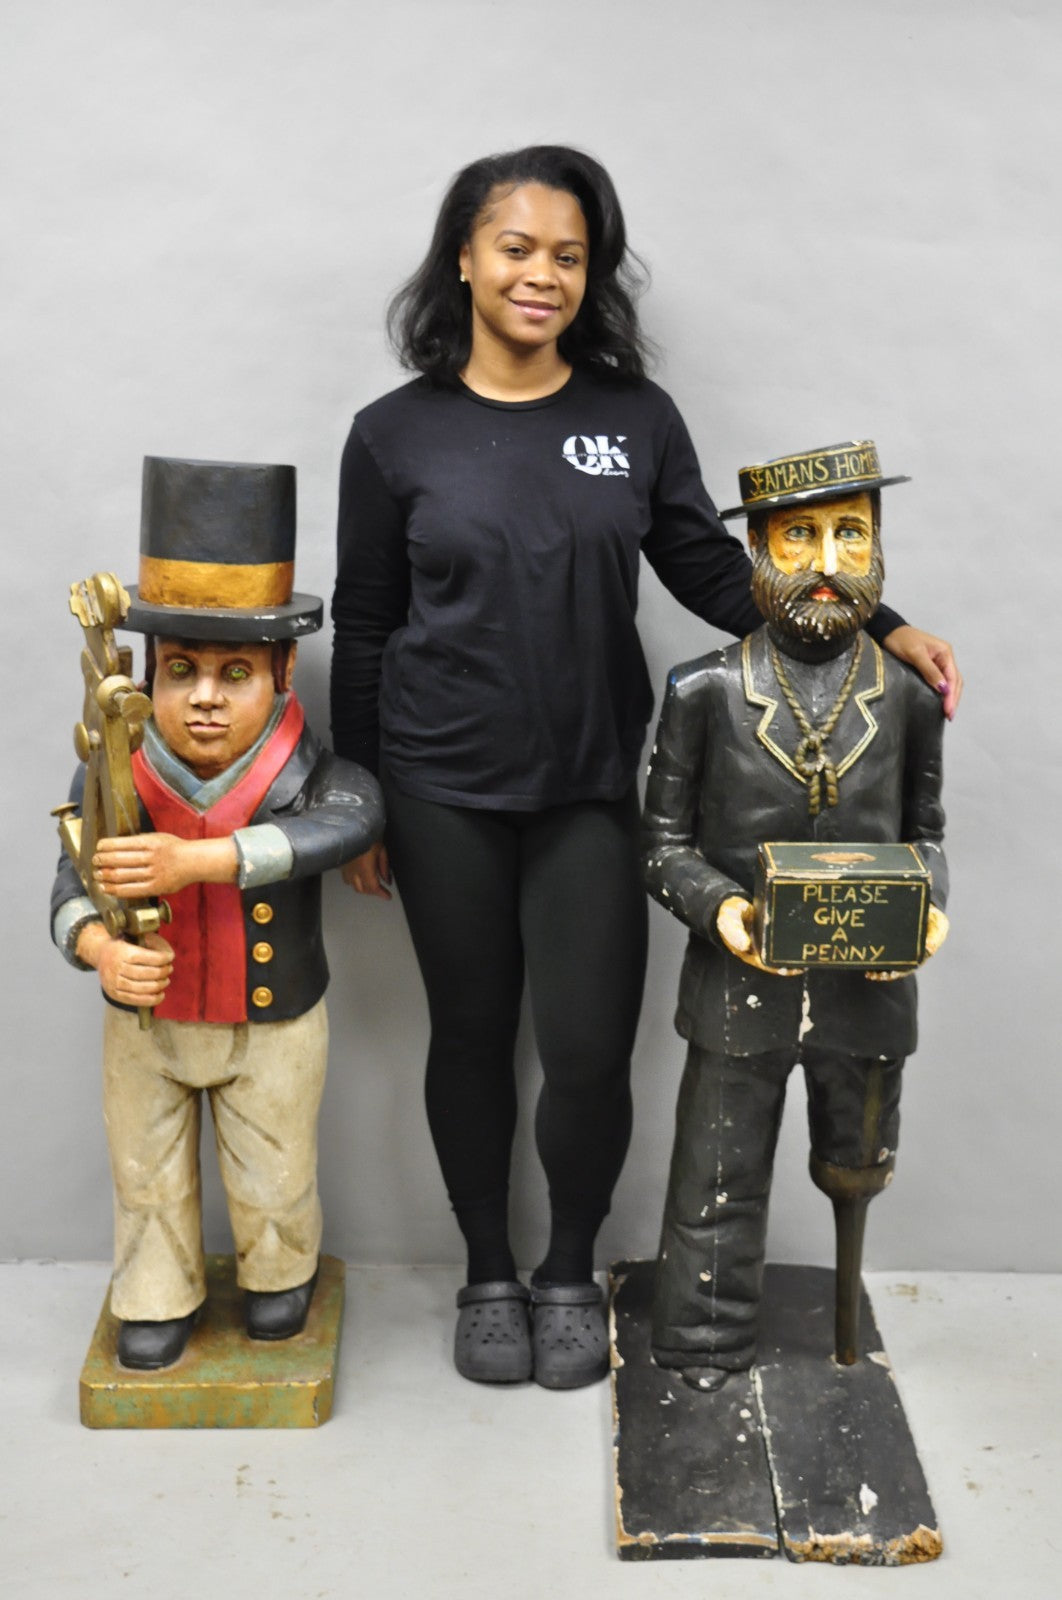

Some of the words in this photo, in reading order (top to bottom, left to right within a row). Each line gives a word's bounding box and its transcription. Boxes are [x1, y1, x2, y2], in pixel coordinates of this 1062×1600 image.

[562, 435, 630, 475] QK
[803, 885, 889, 904] PLEASE
[813, 906, 866, 928] GIVE
[831, 926, 849, 942] A
[802, 944, 885, 961] PENNY
